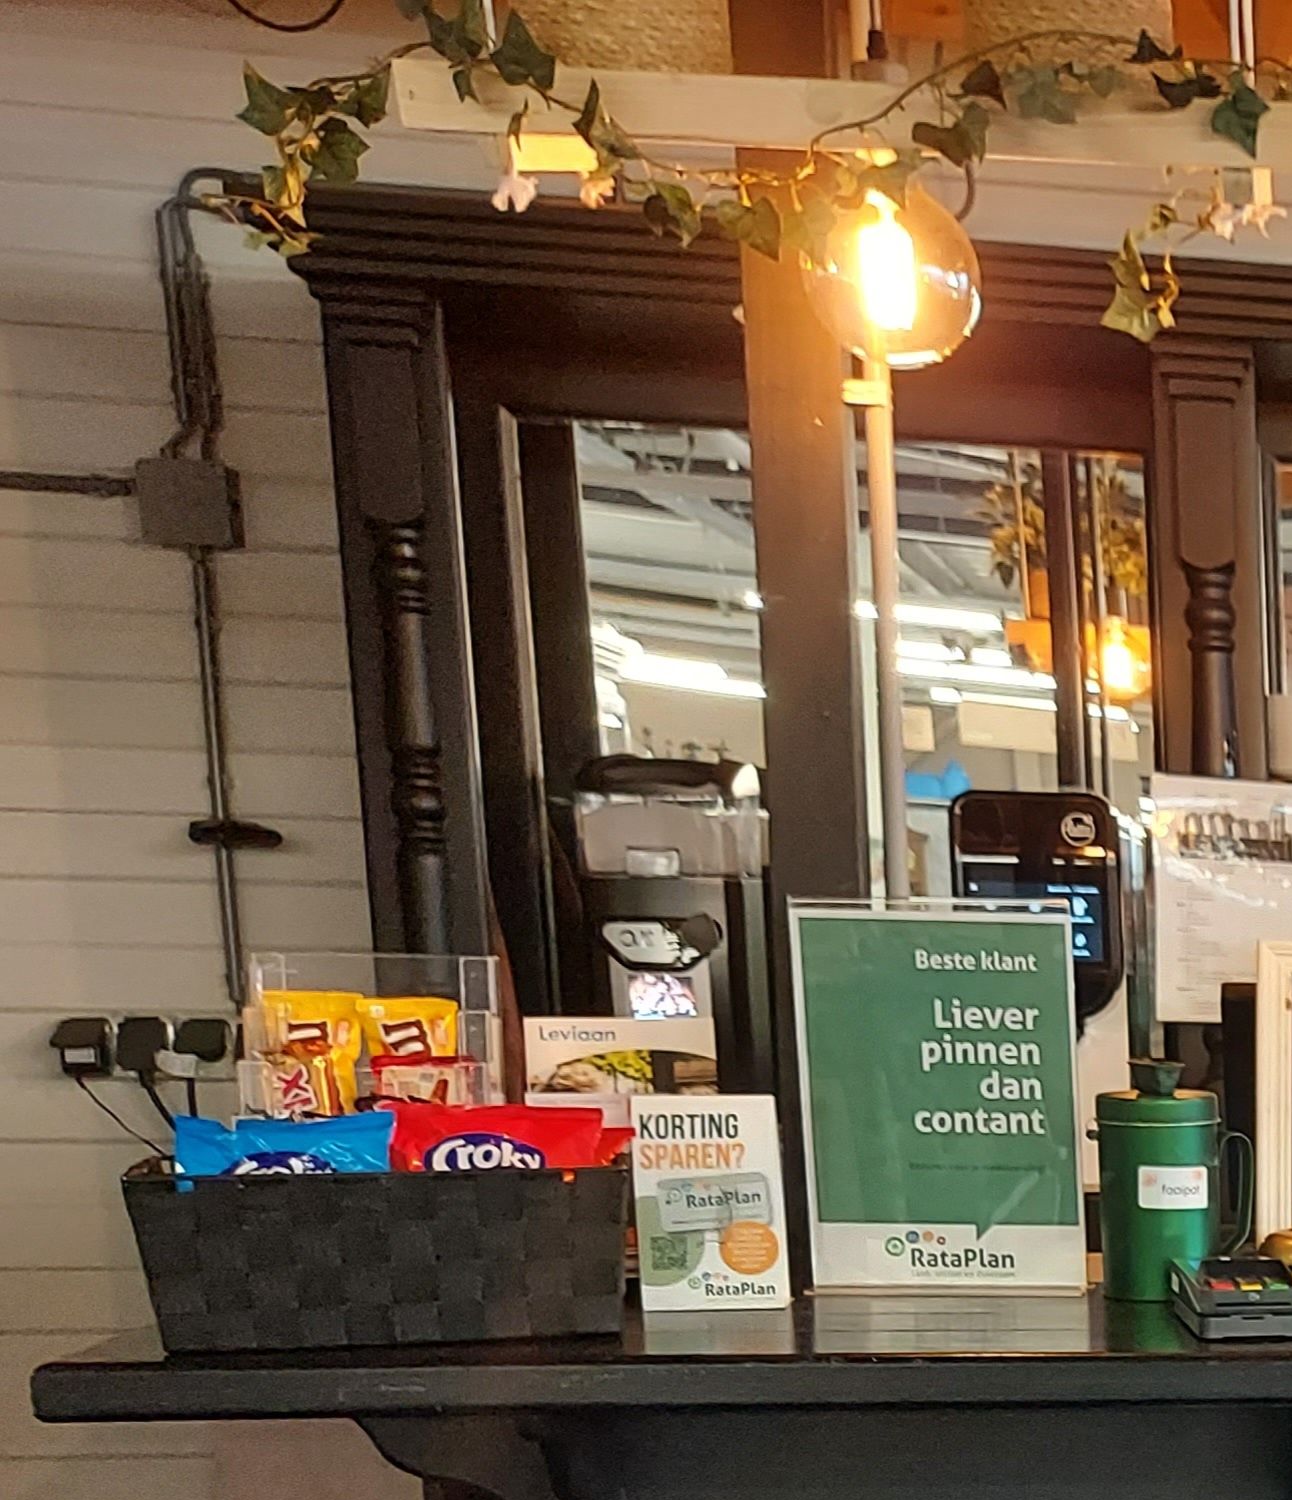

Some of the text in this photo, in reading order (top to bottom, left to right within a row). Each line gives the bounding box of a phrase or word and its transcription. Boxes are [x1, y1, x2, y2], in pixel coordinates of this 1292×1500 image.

[914, 949, 1038, 973] Beste klant
[934, 999, 1038, 1032] Liever
[538, 1025, 616, 1042] Leviaan
[921, 1034, 1041, 1071] pinnen
[980, 1071, 1043, 1102] dan
[639, 1113, 739, 1139] KORTING
[914, 1107, 1045, 1136] contant
[639, 1143, 746, 1169] SPAREN?
[686, 1191, 761, 1209] RataPlan
[911, 1248, 1015, 1269] RataPlan
[705, 1283, 776, 1297] RataPlan
